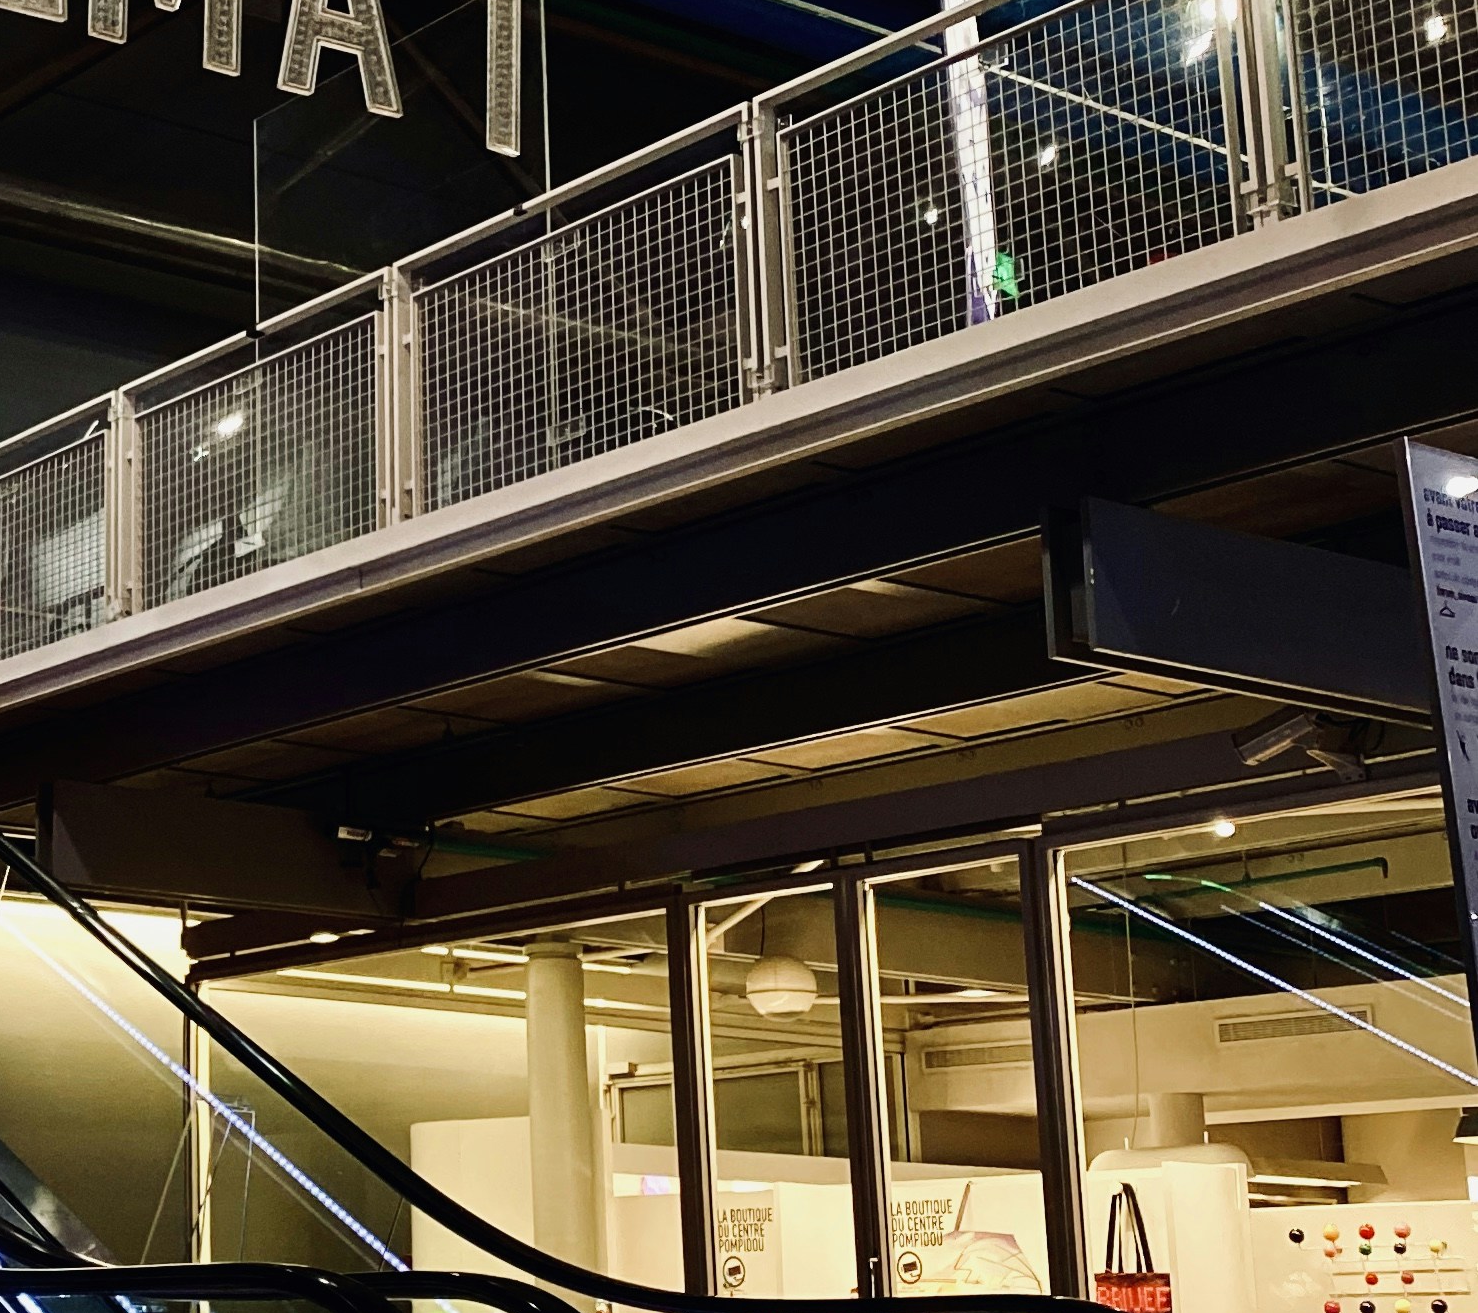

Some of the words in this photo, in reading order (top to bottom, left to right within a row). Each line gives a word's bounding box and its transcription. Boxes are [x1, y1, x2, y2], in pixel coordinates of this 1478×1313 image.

[717, 1209, 728, 1224] LA
[730, 1208, 773, 1223] BOUTIQUE
[890, 1201, 903, 1217] LA
[905, 1199, 953, 1215] BOUTIQUE
[718, 1224, 729, 1238] DU
[732, 1223, 765, 1237] CENTRE
[891, 1217, 904, 1232] DU
[907, 1215, 944, 1231] CENTRE
[719, 1238, 765, 1253] POMPIDOU
[892, 1231, 943, 1248] POMPIDOU
